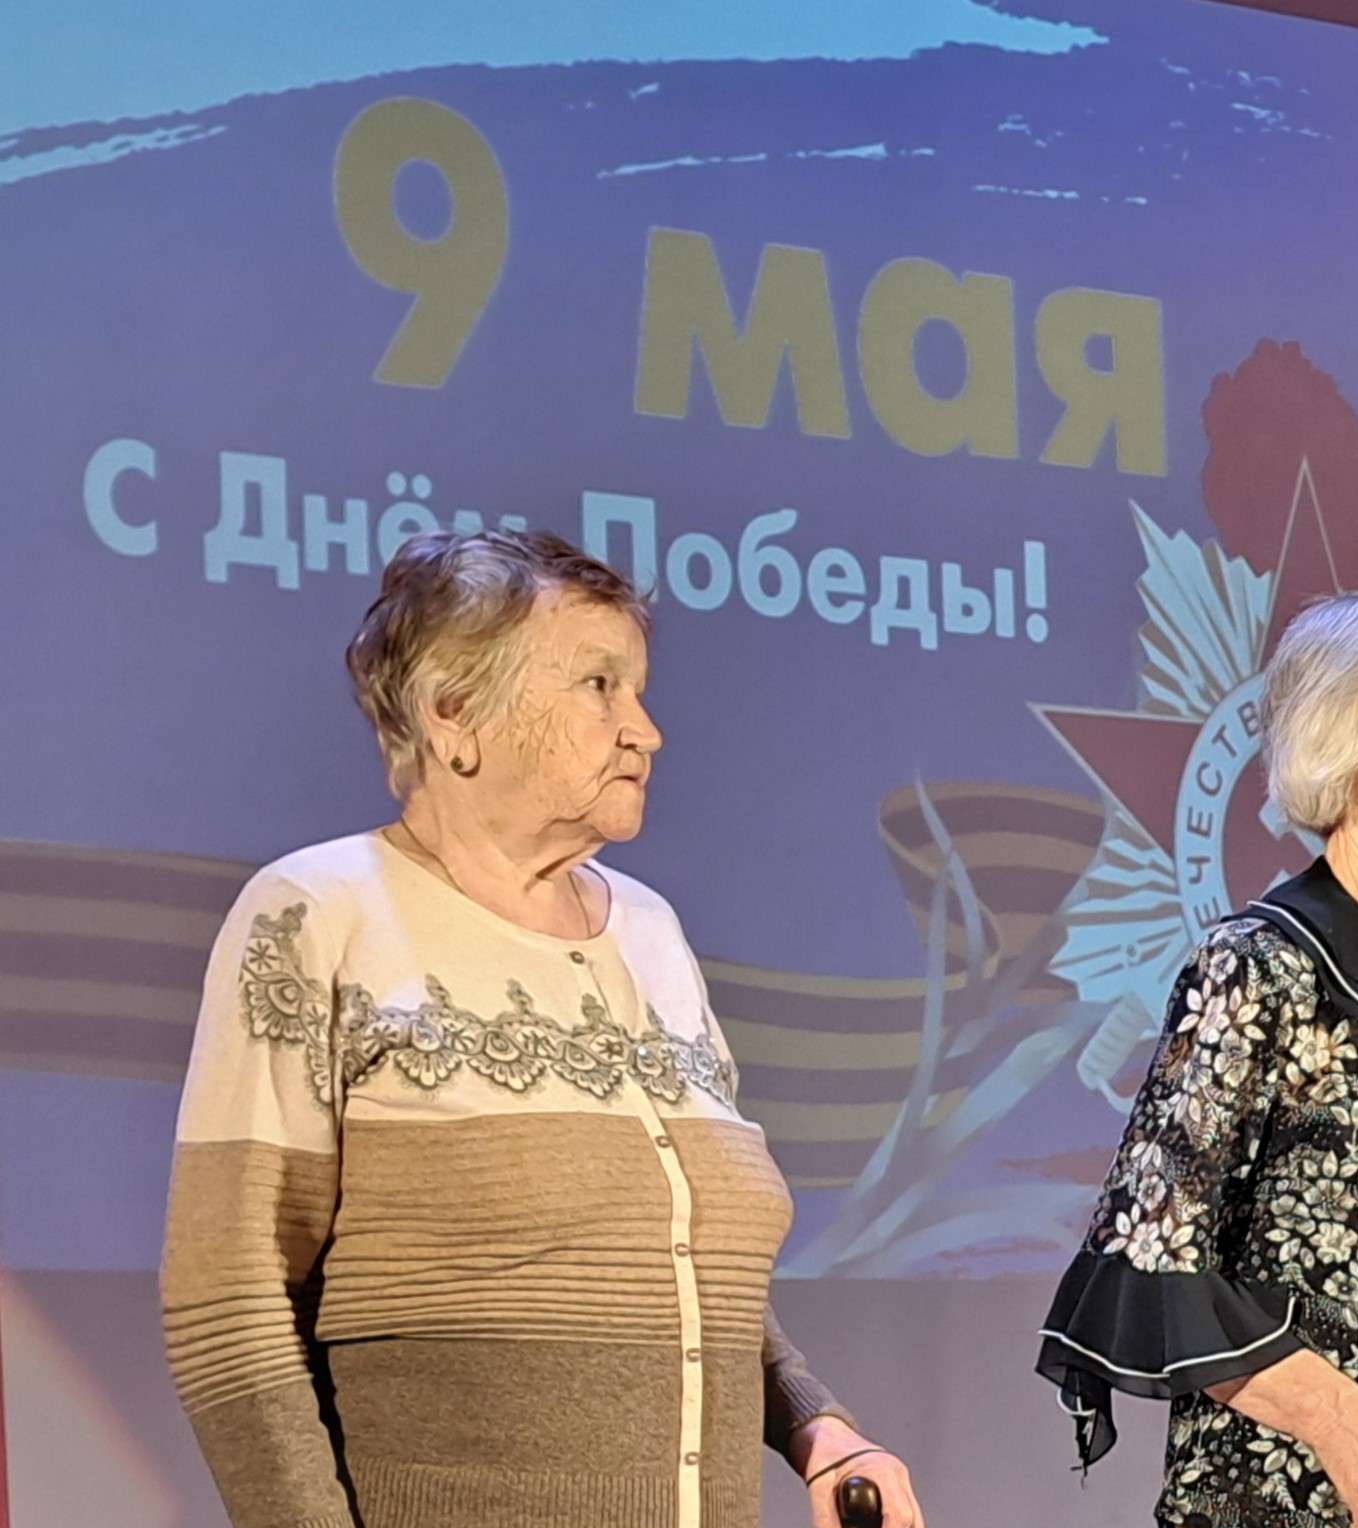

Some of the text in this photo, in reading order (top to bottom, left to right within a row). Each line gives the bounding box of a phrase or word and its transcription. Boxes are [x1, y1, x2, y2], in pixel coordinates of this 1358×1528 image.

[333, 95, 1169, 478] 9 мая
[83, 438, 1049, 651] С Днё Победы!
